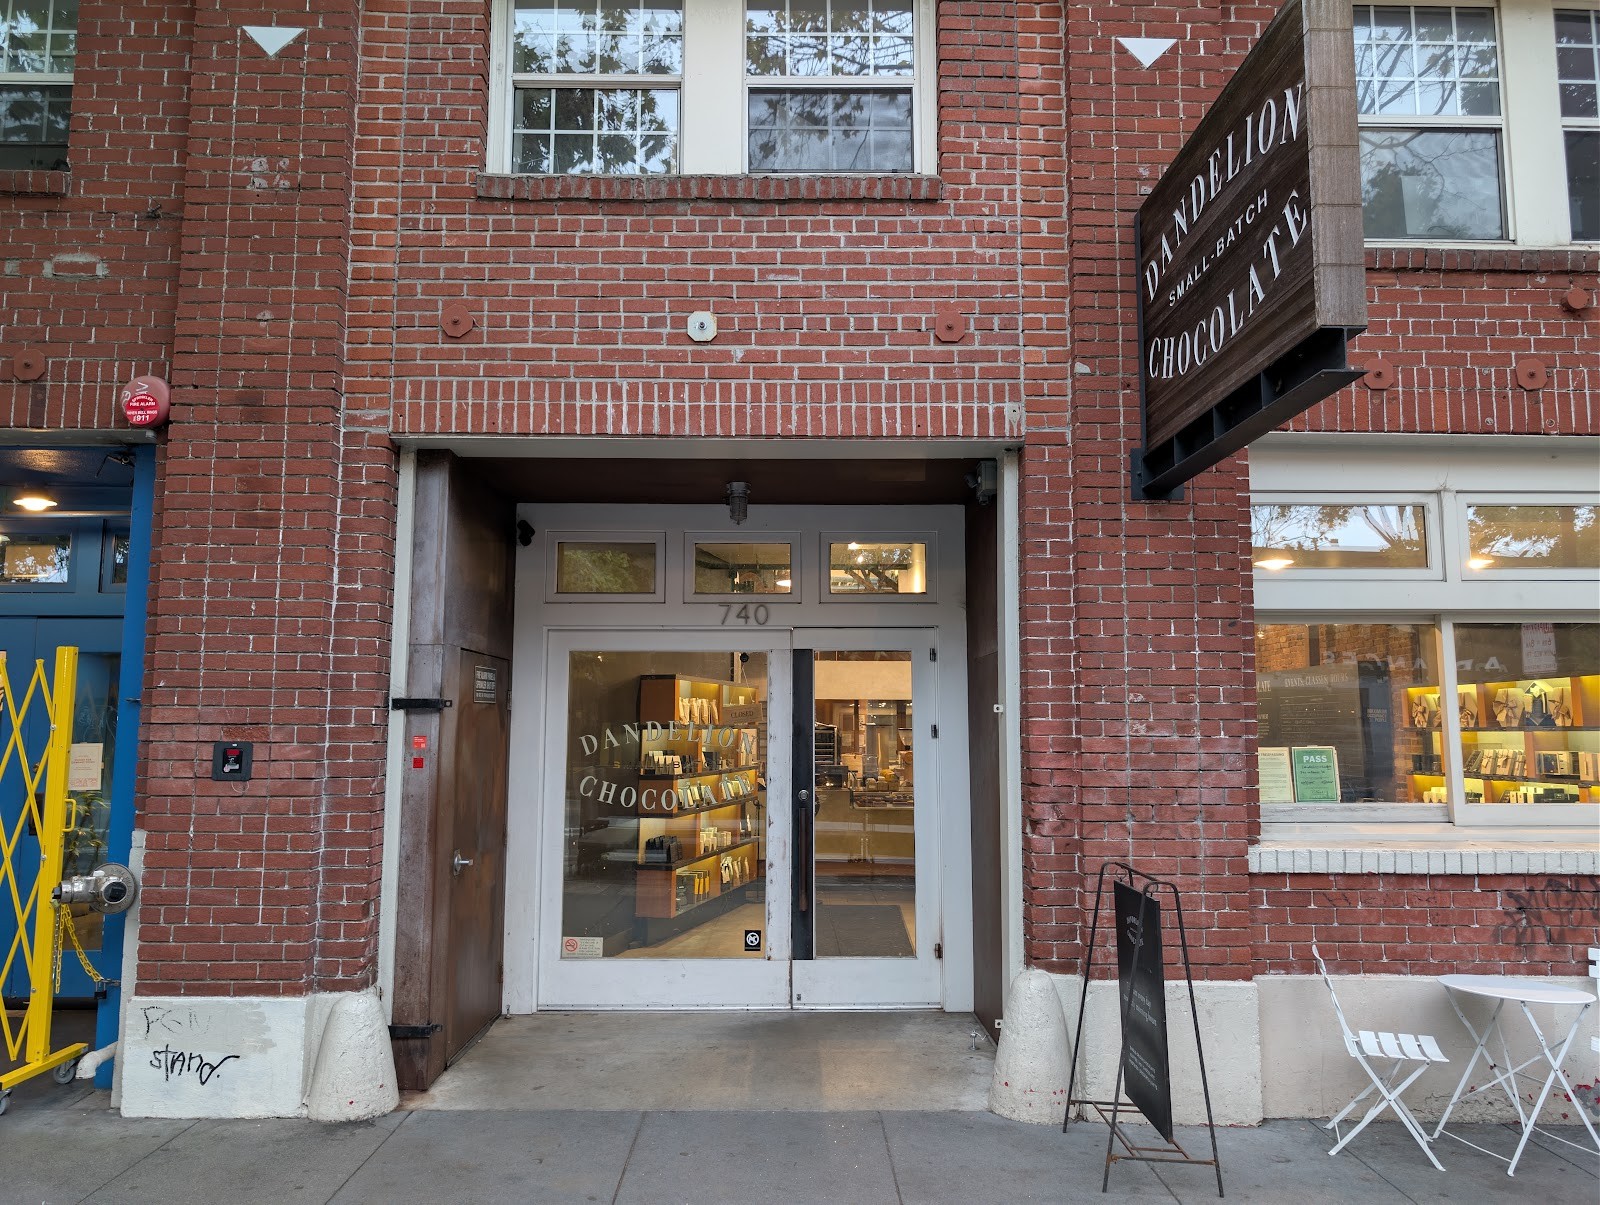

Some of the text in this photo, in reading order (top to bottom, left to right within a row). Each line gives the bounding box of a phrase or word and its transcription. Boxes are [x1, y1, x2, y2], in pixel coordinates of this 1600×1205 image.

[1145, 82, 1304, 303] DANDELION
[1169, 189, 1268, 307] SMALL-BATCH
[1149, 189, 1307, 379] CHOCOLATE
[718, 604, 769, 626] 740
[730, 711, 754, 719] CLOSED
[579, 720, 758, 756] DANDELION
[1303, 755, 1328, 763] PASS
[579, 772, 755, 811] CHOCOLATE
